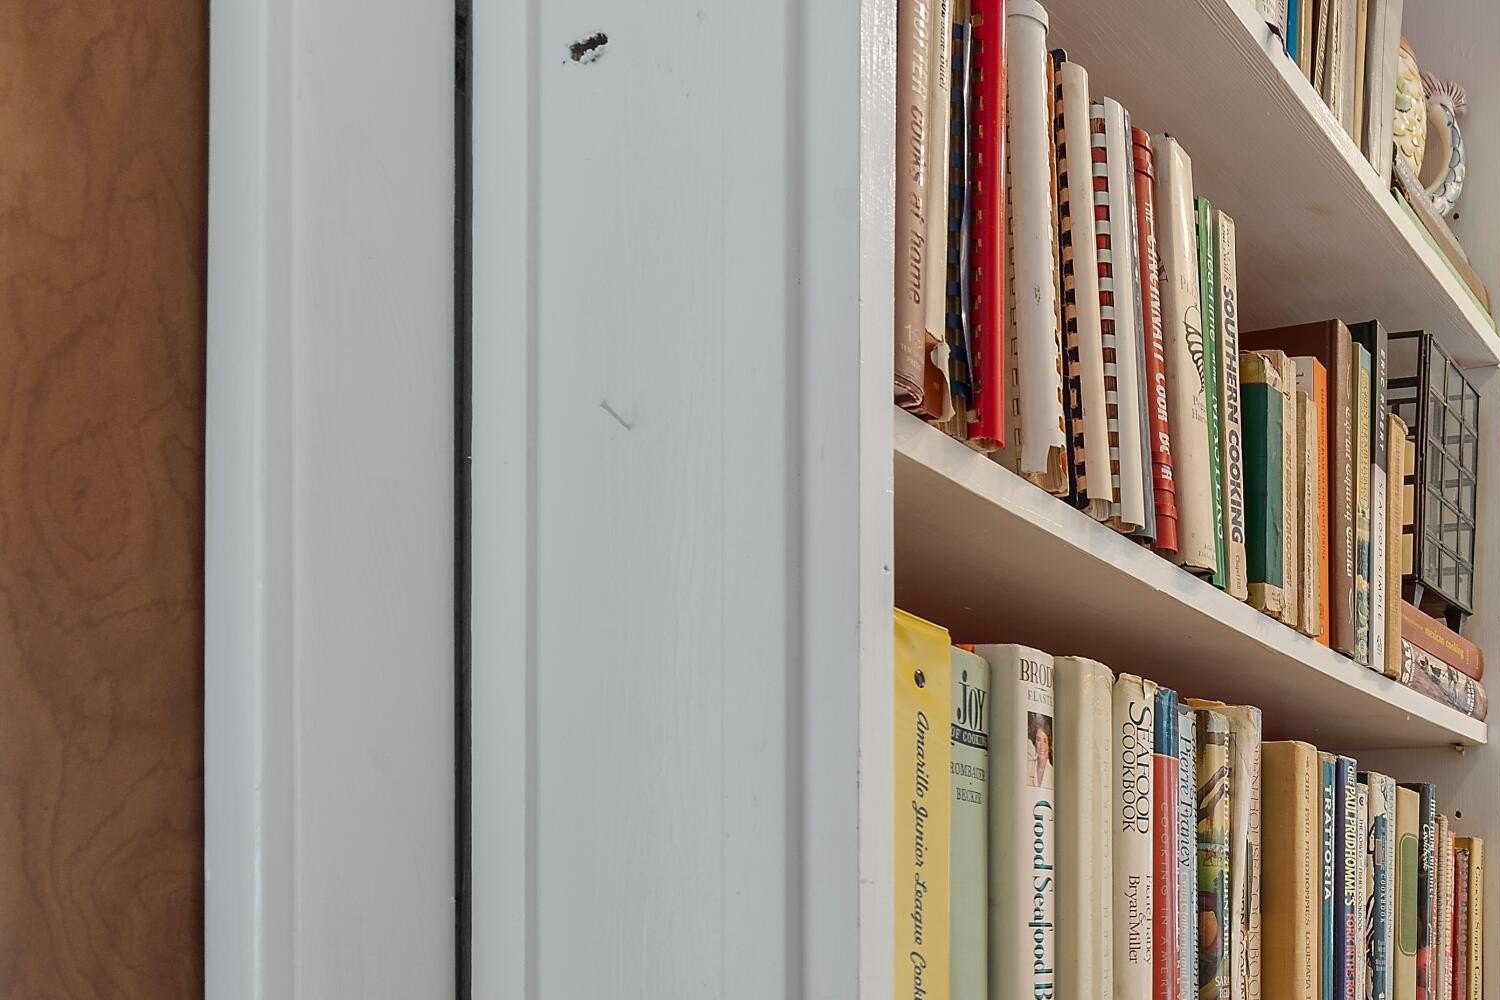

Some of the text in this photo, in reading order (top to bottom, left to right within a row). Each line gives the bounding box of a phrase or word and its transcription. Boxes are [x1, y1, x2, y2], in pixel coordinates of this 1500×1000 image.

[912, 0, 929, 100] ROTTER
[908, 228, 925, 305] home
[1223, 285, 1245, 545] SOUTHERN COOKING
[1378, 348, 1386, 452] ERIC RIPERT
[1377, 482, 1385, 621] SEAFOOD SIMPLE
[912, 710, 930, 798] Amarillo
[955, 786, 983, 805] BECKER
[1121, 721, 1136, 834] COOKBOOK
[1128, 701, 1152, 835] SEAFOOD
[1179, 735, 1193, 868] Pierre Franey
[911, 799, 930, 868] Junior
[1032, 799, 1054, 871] Good
[1160, 801, 1169, 896] COOKING
[1323, 784, 1333, 901] TRATTORIA
[1344, 766, 1357, 908] CHEF PAUL PRUDHOMME'S
[910, 870, 929, 946] League
[1028, 873, 1054, 975] Seafood
[1124, 874, 1142, 964] Bryan Miller
[1160, 908, 1169, 925] IN
[1304, 840, 1312, 926] PRUDHOMME'S
[1345, 912, 1356, 942] FORK
